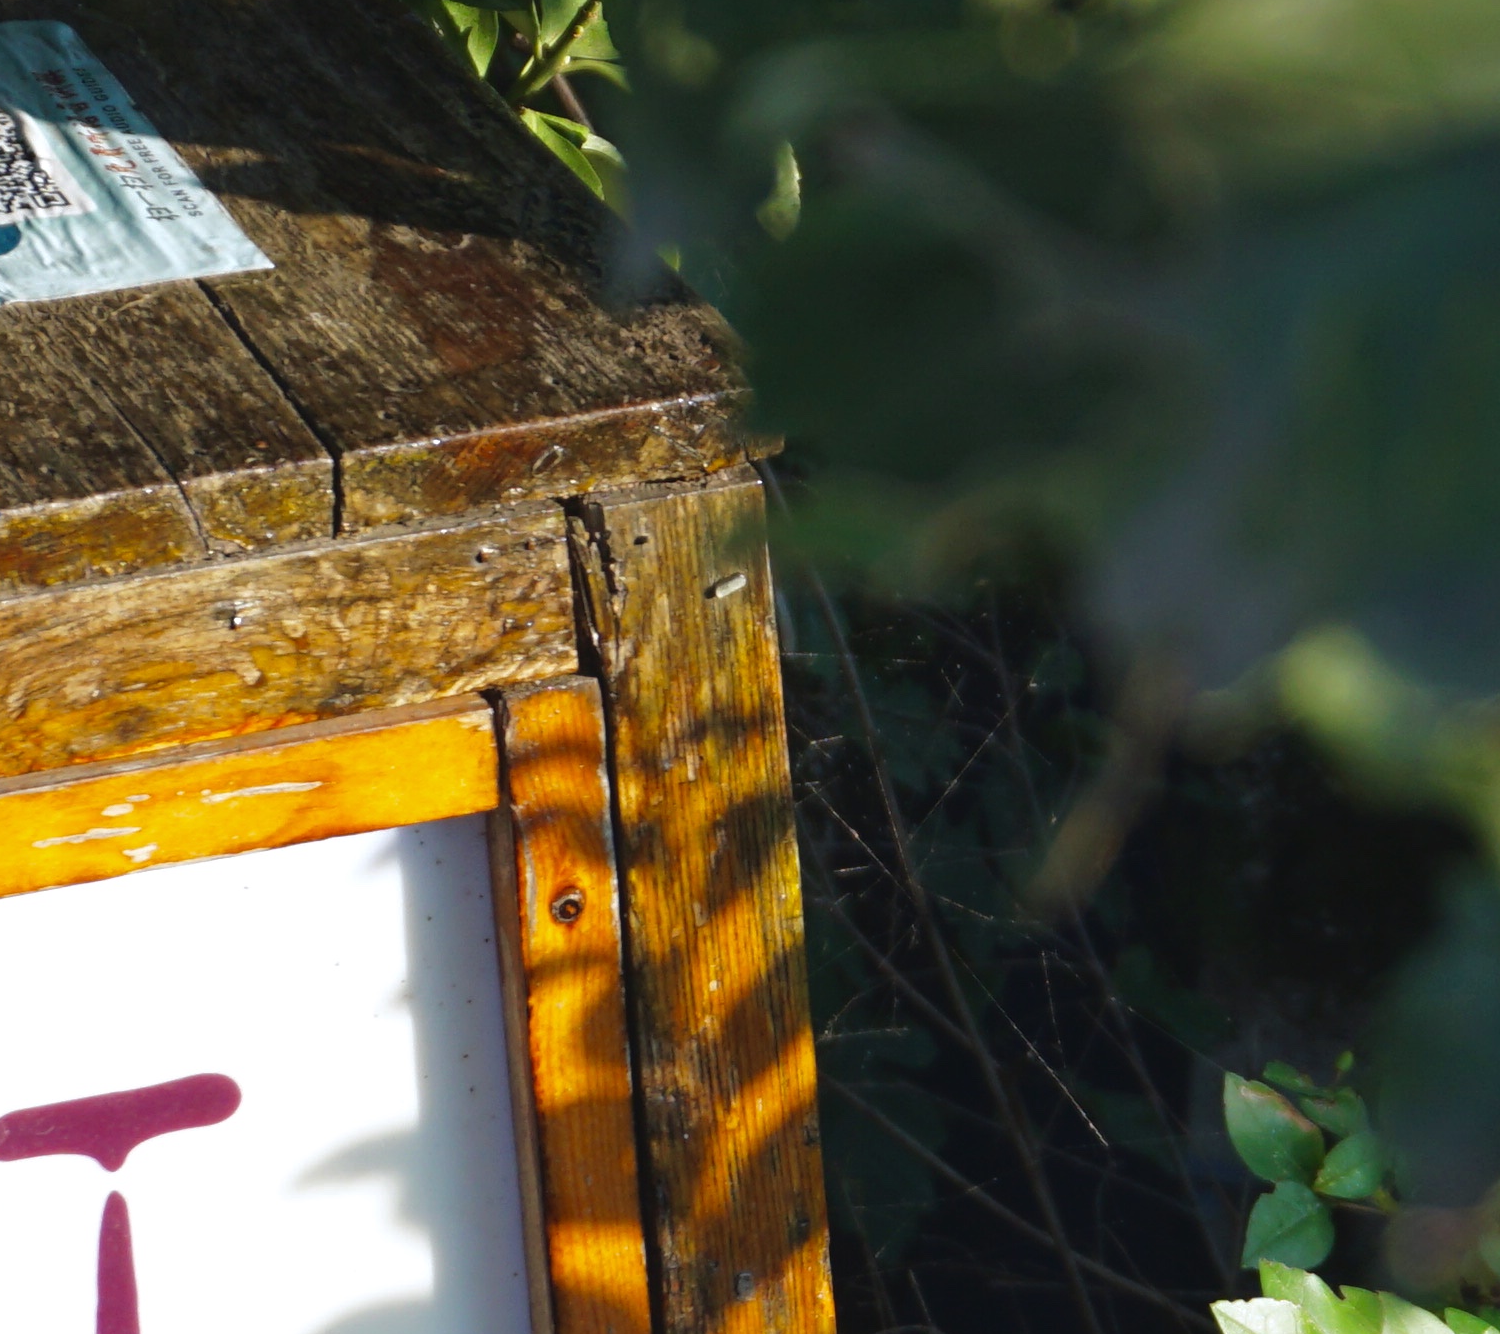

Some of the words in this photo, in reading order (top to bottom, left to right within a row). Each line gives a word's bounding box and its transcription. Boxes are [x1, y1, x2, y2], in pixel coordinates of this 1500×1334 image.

[102, 105, 136, 134] AUDIO
[127, 138, 159, 163] FREE
[152, 166, 180, 187] FOR
[173, 189, 204, 217] SCAN
